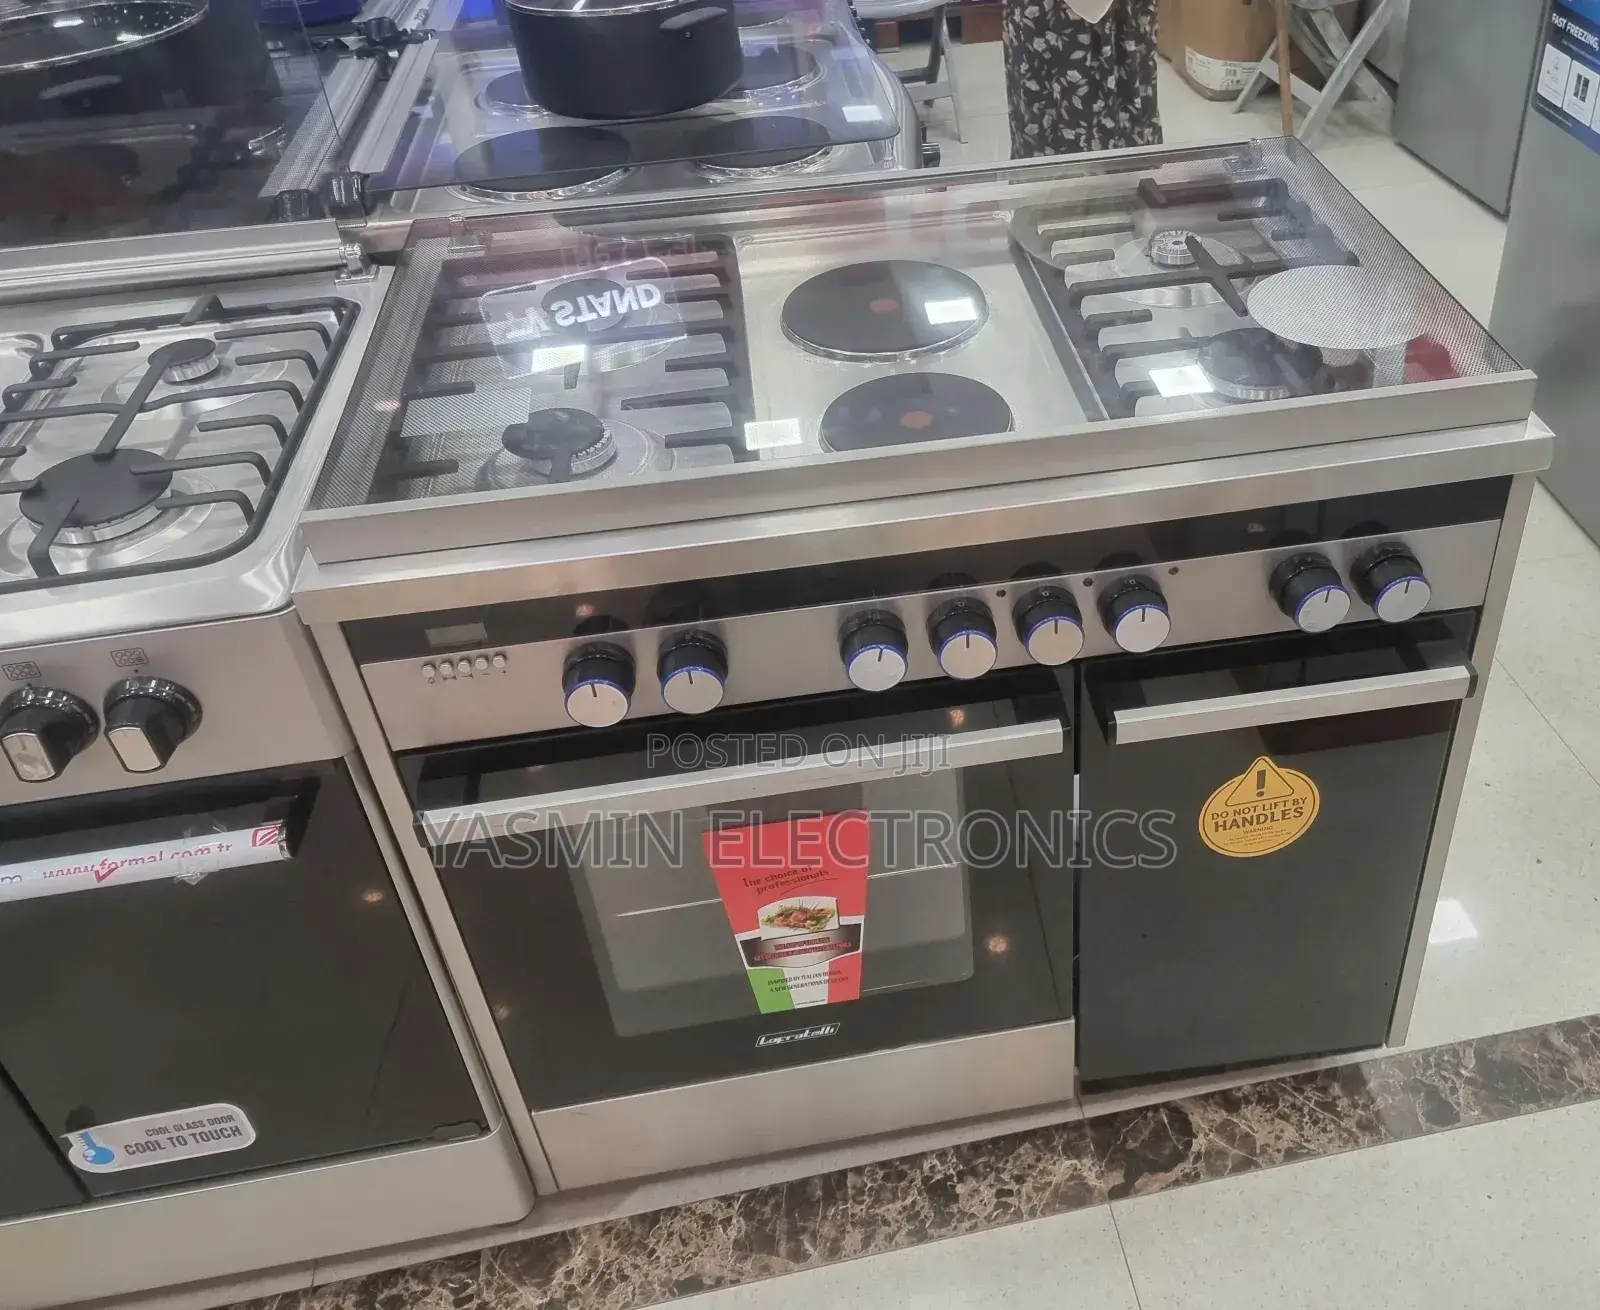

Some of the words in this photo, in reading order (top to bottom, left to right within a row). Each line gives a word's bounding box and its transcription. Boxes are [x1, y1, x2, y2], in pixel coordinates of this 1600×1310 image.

[1551, 13, 1566, 30] FAST
[1211, 810, 1229, 821] DO
[1233, 805, 1260, 818] NOT
[1262, 800, 1290, 812] LIFT
[1291, 796, 1308, 807] BY
[1213, 806, 1305, 833] HANDLES
[1243, 826, 1274, 835] WARNING
[42, 843, 232, 882] wwwformalcomtr
[742, 877, 764, 888] The
[765, 867, 799, 882] choice
[801, 865, 812, 873] of
[756, 868, 830, 895] professionals
[144, 1126, 171, 1138] COOL
[173, 1120, 206, 1134] GLASS
[206, 1114, 236, 1127] DOOR
[123, 1141, 166, 1156] COOL
[166, 1135, 189, 1149] TO
[188, 1125, 243, 1144] TOUCH
